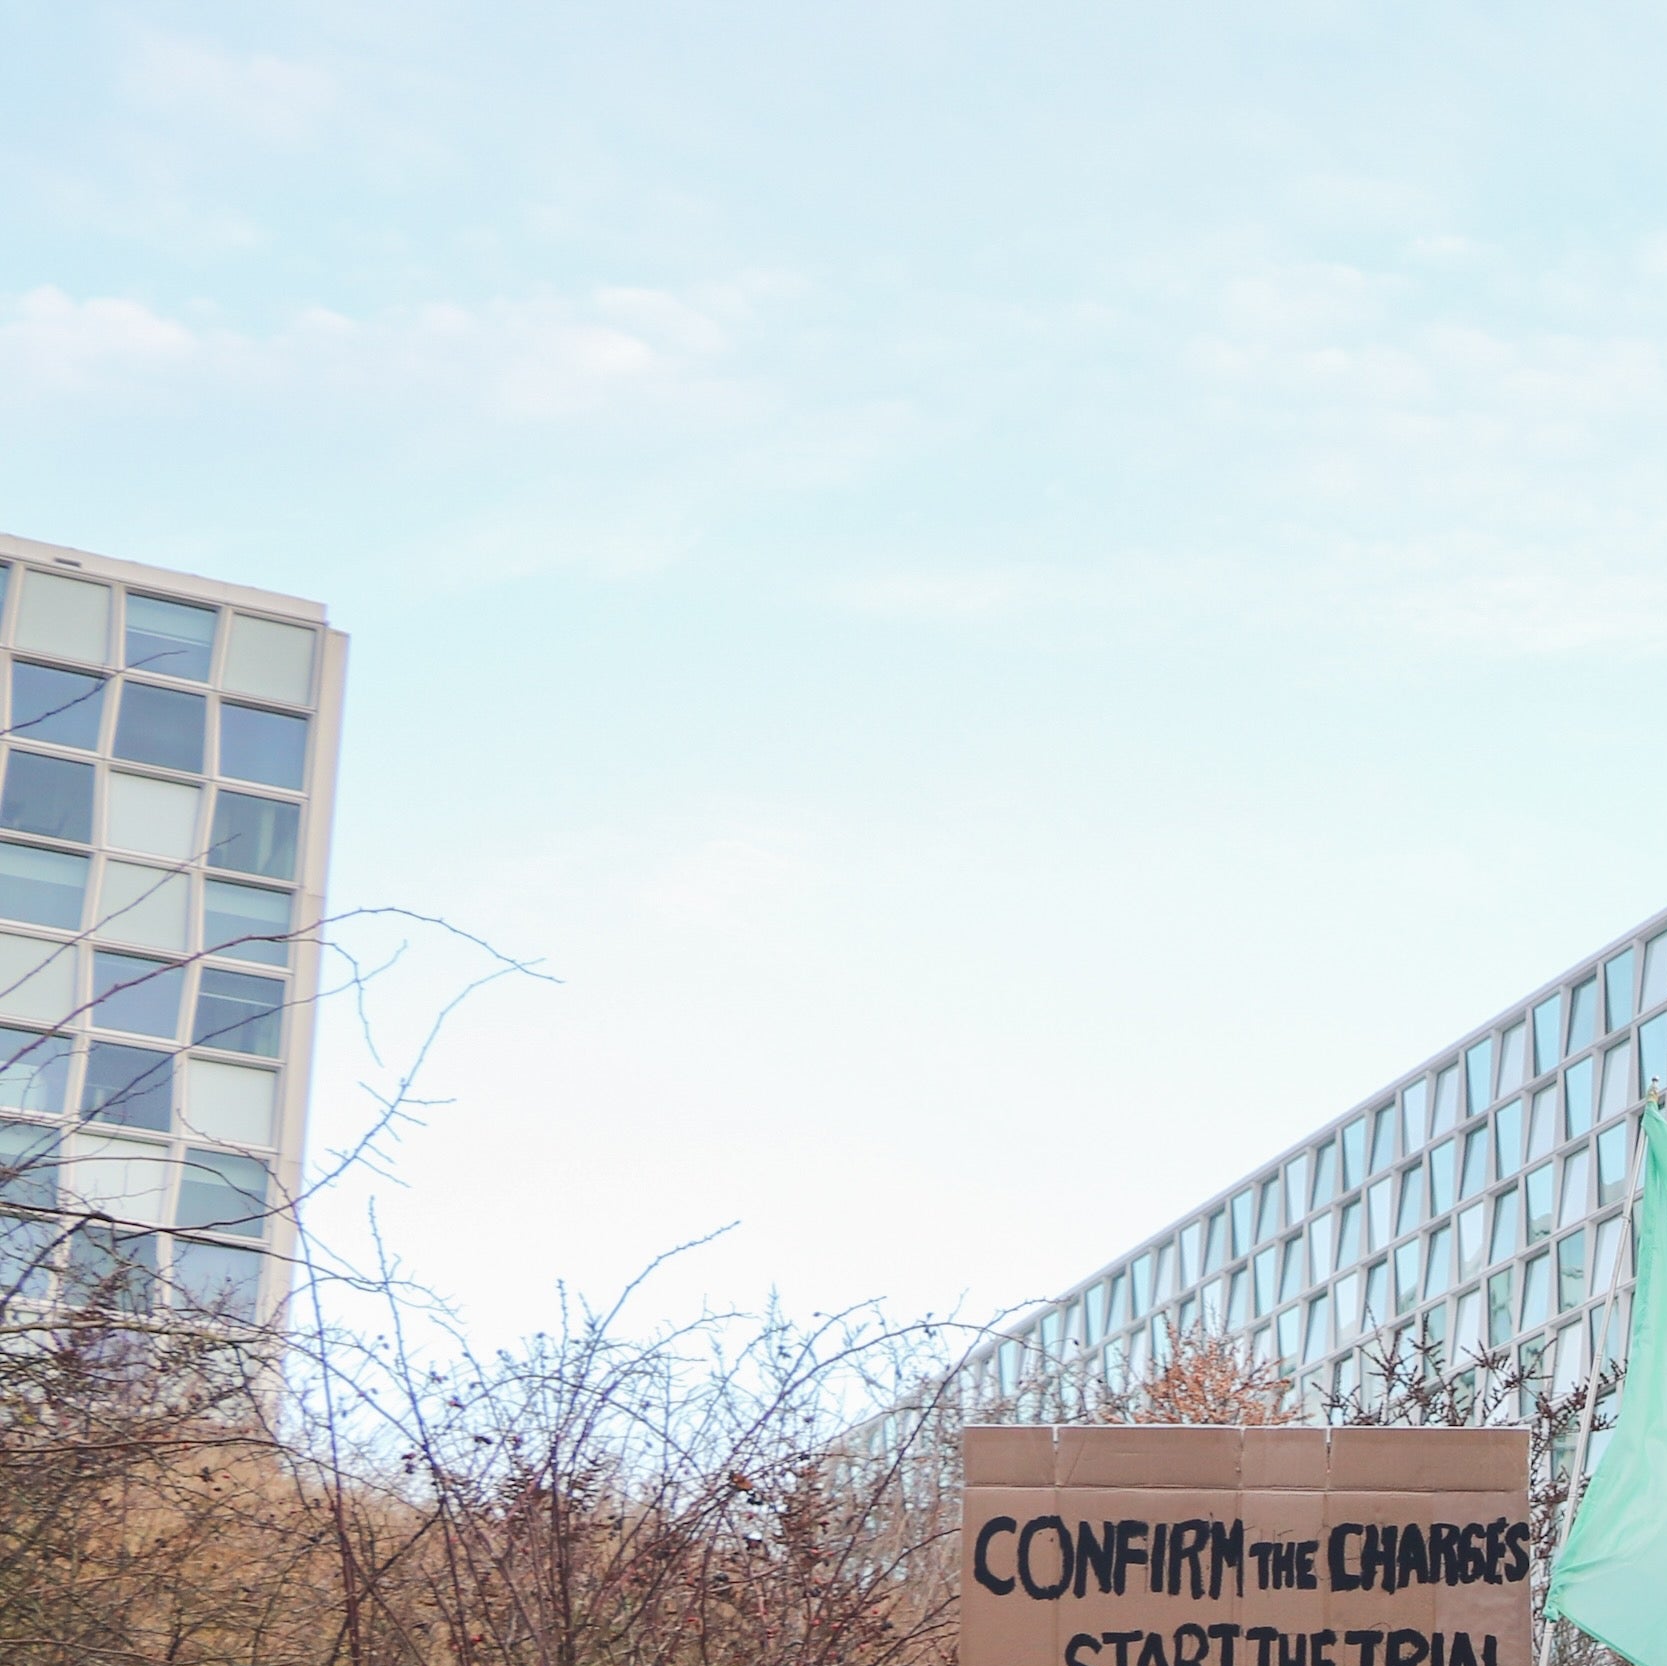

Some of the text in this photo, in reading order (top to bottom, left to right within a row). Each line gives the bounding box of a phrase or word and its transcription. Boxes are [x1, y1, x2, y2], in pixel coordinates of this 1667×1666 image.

[973, 1514, 1531, 1600] CONFIRM THE CHARGES
